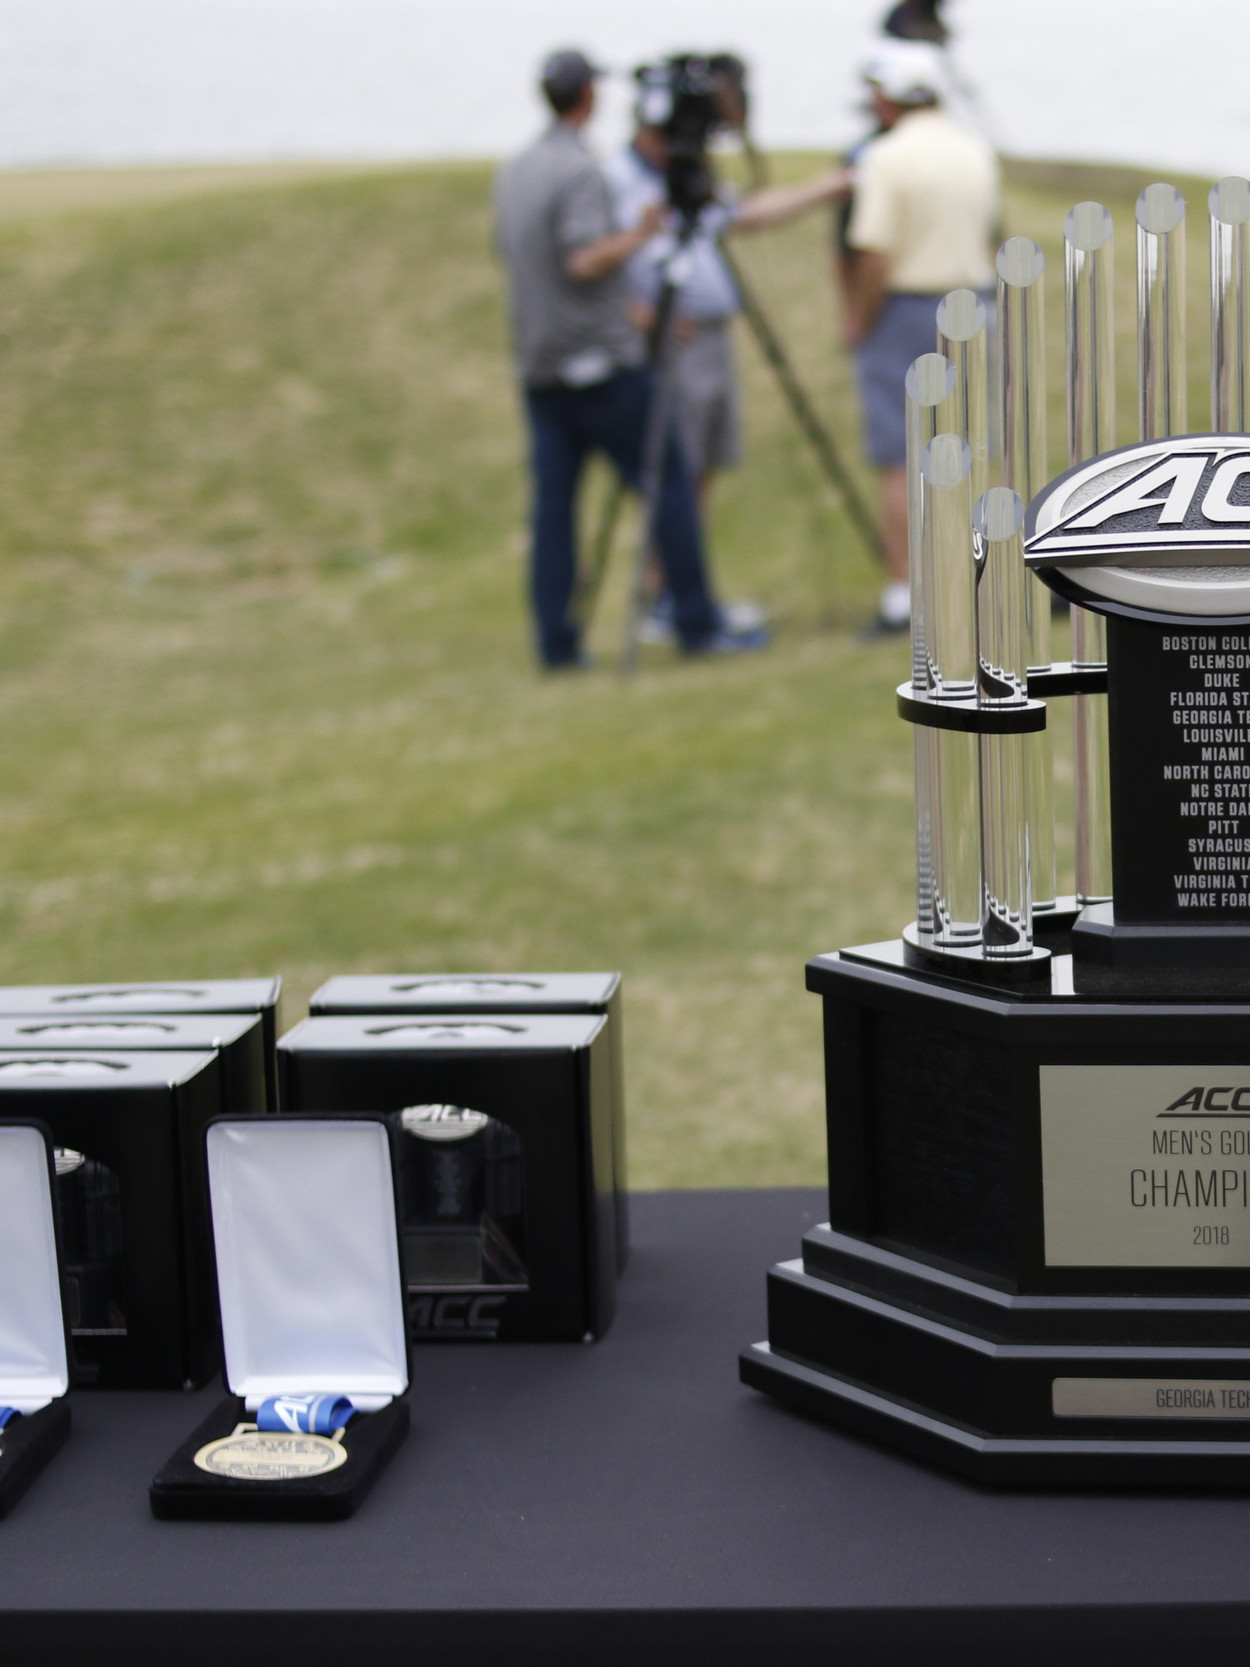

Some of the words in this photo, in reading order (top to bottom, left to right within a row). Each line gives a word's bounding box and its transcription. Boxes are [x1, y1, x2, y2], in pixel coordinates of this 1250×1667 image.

[1162, 636, 1217, 651] BOSTON
[1204, 673, 1240, 688] DUKE
[1170, 691, 1228, 706] FLORIDA
[1173, 710, 1233, 725] GEORGIA
[1201, 746, 1245, 761] MIAMI
[1163, 765, 1209, 780] NORTH
[1191, 783, 1209, 798] NC
[1180, 801, 1224, 816] NOTRE
[1208, 820, 1240, 835] PITT
[1173, 874, 1236, 889] VIRGINIA
[1177, 892, 1217, 907] WAKE
[1152, 1130, 1212, 1156] MEN'S
[1193, 1225, 1230, 1246] 2018
[1155, 1388, 1216, 1409] GEORGIA
